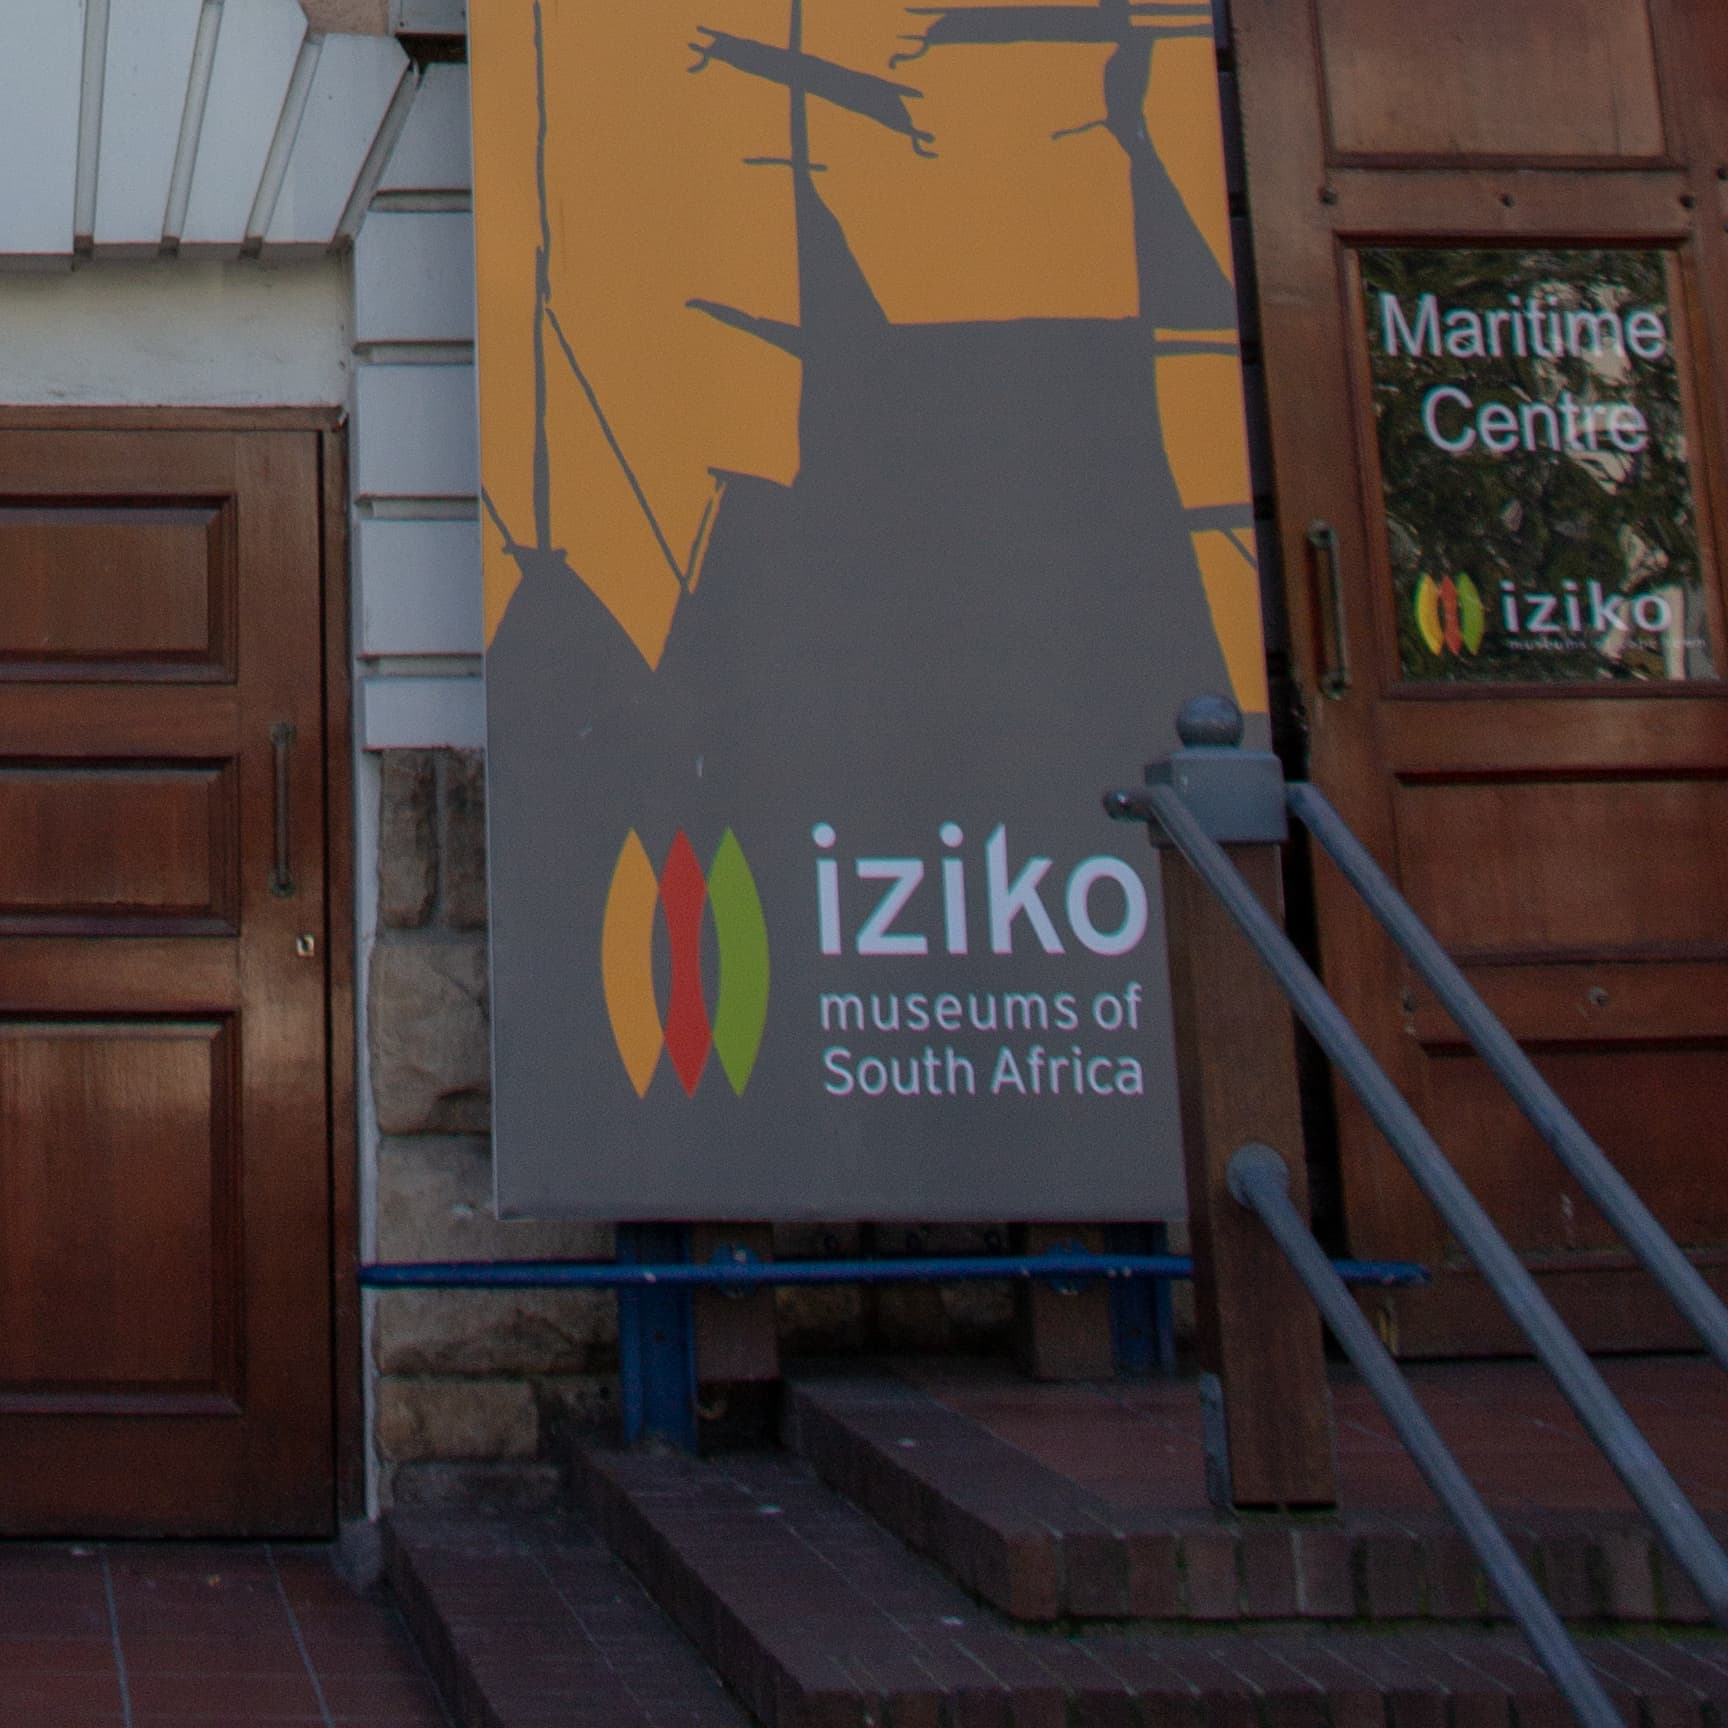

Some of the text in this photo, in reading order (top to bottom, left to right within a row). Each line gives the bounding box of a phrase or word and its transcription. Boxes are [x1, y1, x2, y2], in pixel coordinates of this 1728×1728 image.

[1378, 292, 1668, 359] Maritime
[1421, 385, 1649, 453] Centre
[1499, 578, 1672, 634] iziko
[811, 822, 1148, 956] iziko
[820, 981, 1142, 1031] museums of
[823, 1045, 1144, 1096] South Africa
